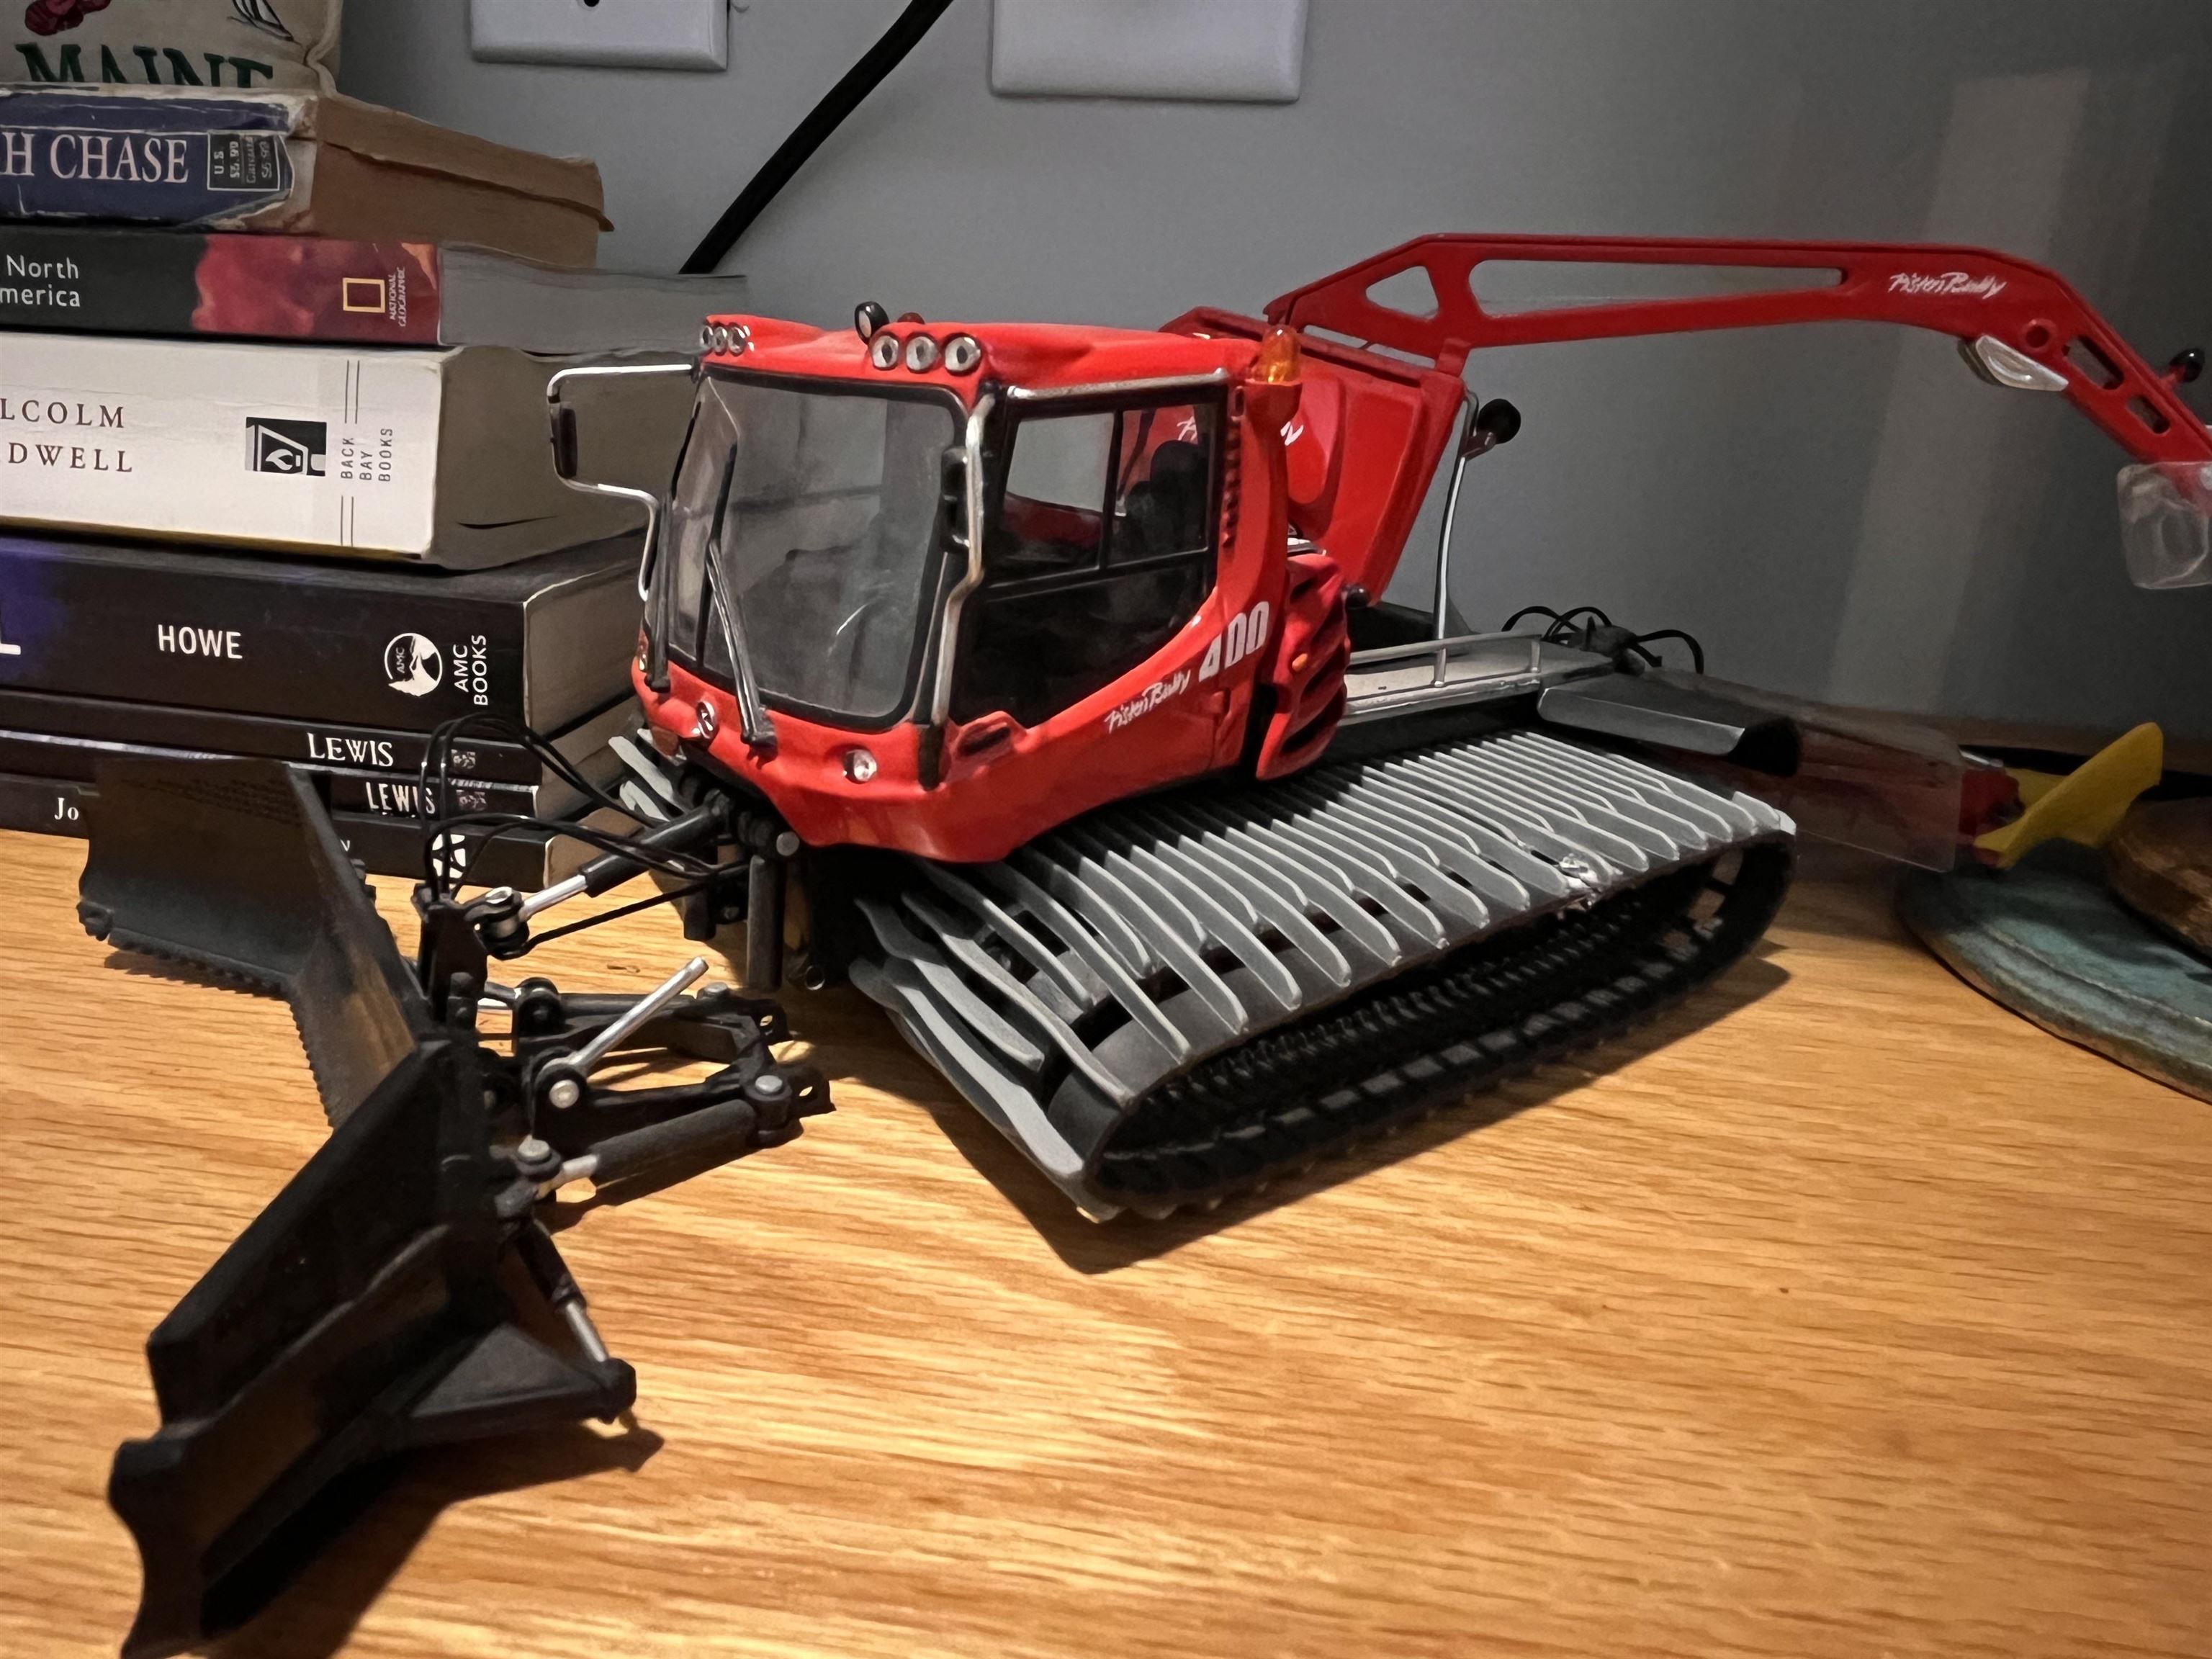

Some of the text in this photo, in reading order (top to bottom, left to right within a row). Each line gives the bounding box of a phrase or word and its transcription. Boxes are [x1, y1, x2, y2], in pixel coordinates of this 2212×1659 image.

[50, 134, 189, 184] CHASE
[6, 254, 79, 279] North
[0, 284, 81, 307] merica
[0, 397, 124, 428] LCOLM
[8, 442, 132, 472] DWELL
[341, 438, 354, 480] BACK
[359, 451, 373, 481] BAY
[378, 428, 393, 482] BOOKS
[158, 624, 243, 659] HOWE
[1198, 601, 1269, 683] 400
[396, 647, 405, 674] AMC
[453, 644, 469, 693] AMC
[471, 634, 488, 706] BOOKS
[307, 732, 394, 767] LEWIS
